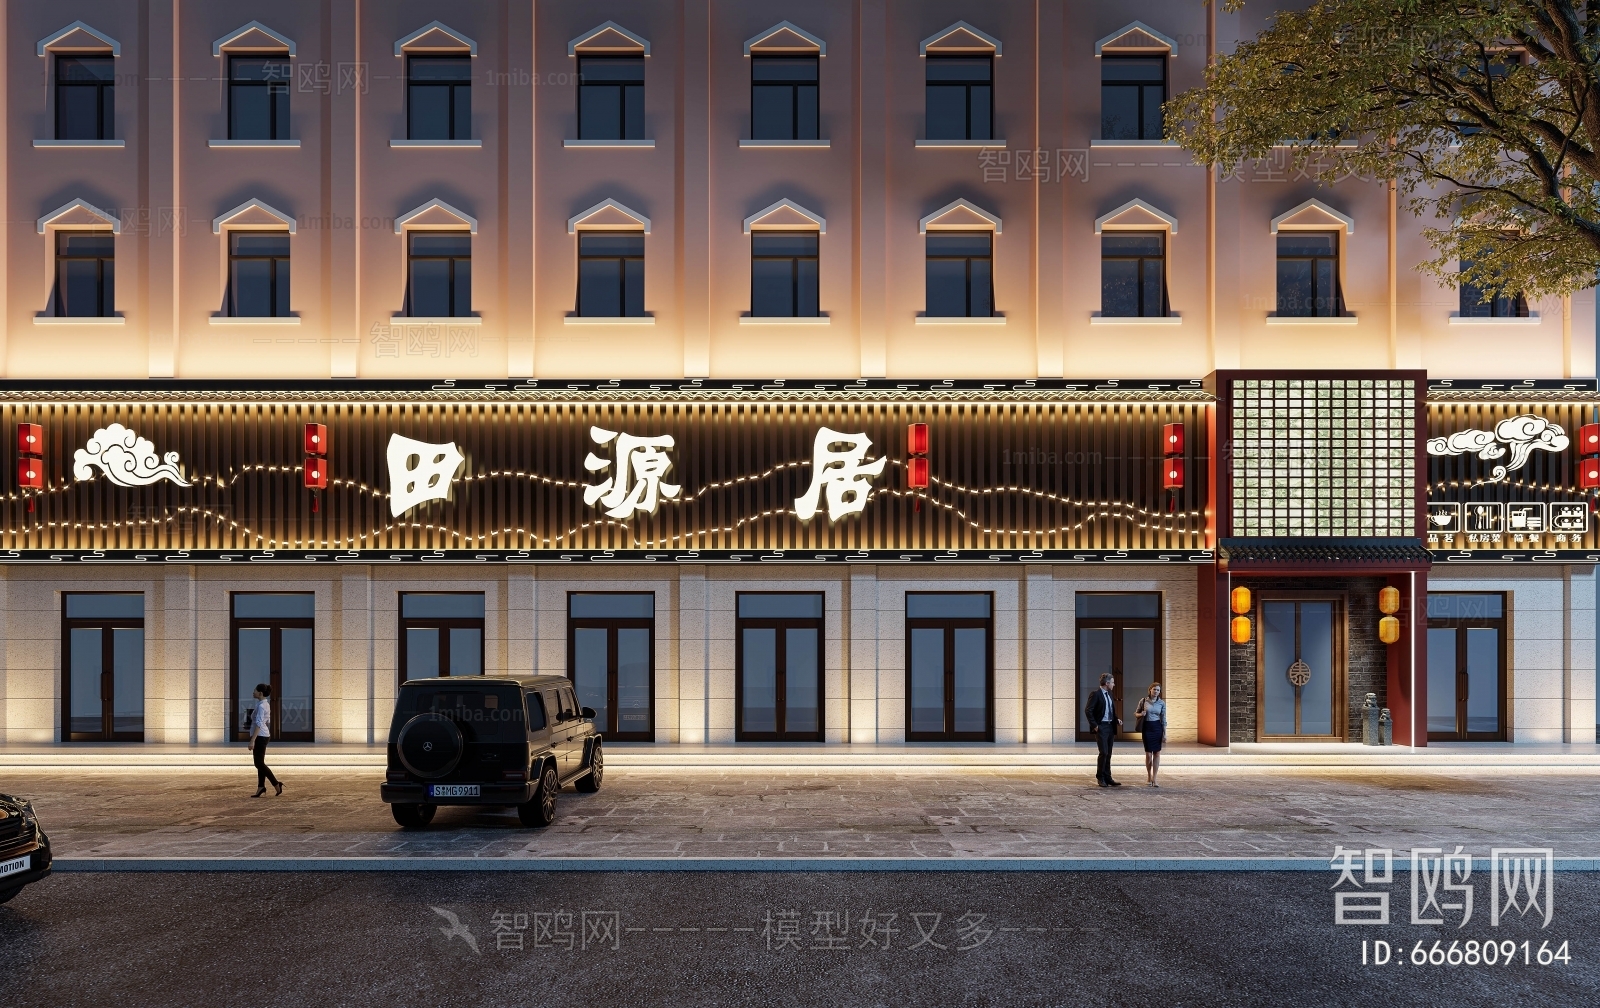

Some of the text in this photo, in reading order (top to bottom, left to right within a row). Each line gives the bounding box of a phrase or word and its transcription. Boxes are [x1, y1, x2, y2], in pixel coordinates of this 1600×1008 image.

[387, 426, 887, 522] 田源居
[1468, 534, 1501, 543] 私房菜
